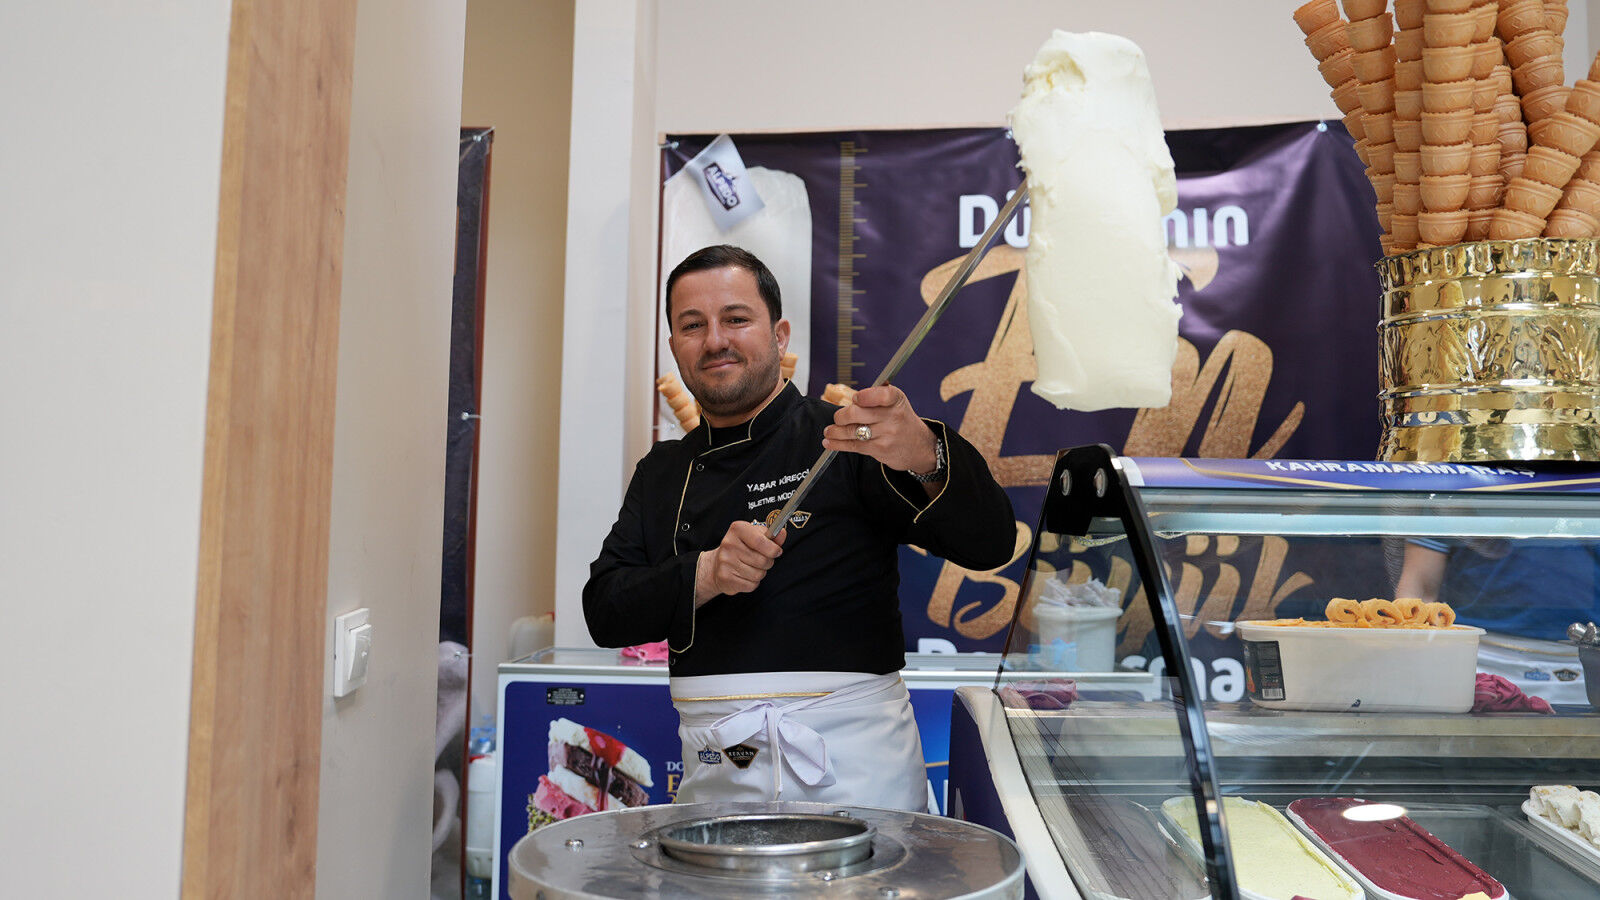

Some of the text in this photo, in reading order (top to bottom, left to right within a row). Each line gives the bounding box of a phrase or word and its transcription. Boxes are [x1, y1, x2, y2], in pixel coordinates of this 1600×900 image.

[706, 166, 738, 207] ALPEDO
[959, 190, 1250, 248] Dünın
[746, 480, 776, 492] YAŞAR
[748, 496, 776, 510] İŞLETME
